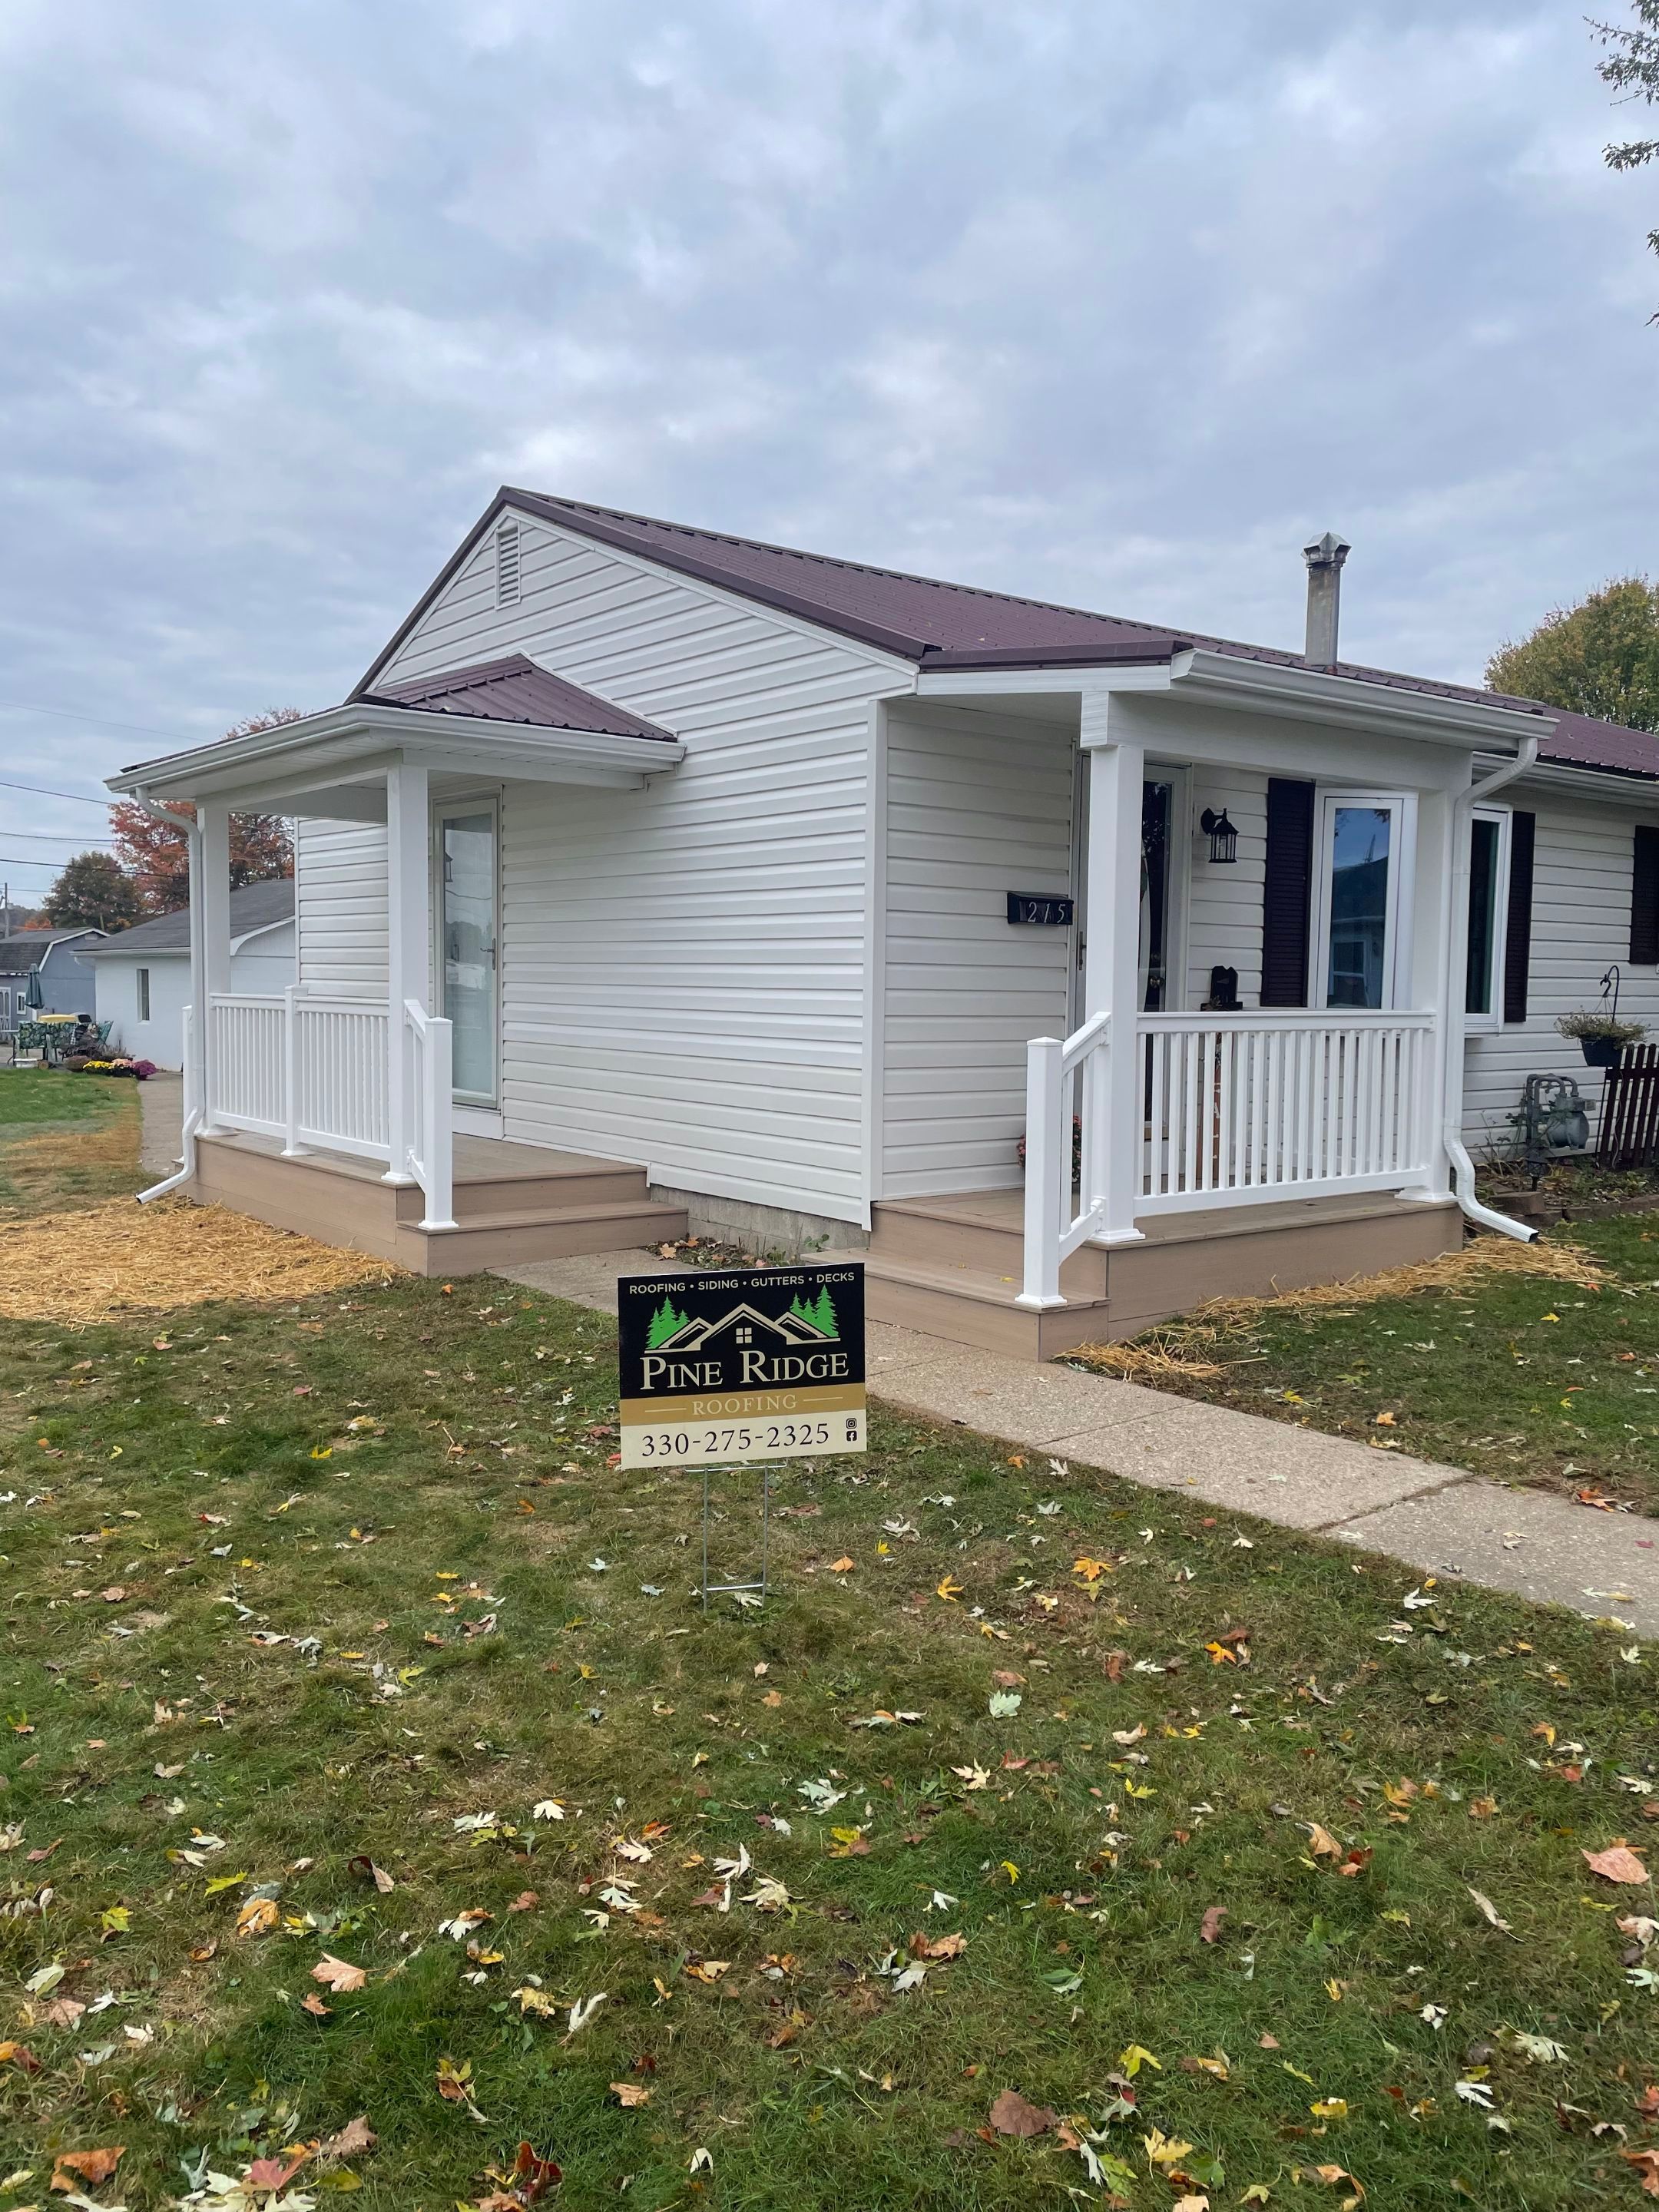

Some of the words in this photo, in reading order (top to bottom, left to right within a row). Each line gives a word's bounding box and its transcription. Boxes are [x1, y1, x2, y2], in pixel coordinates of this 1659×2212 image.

[1028, 902, 1065, 923] 215
[629, 1282, 686, 1295] ROOFING
[697, 1279, 739, 1290] SIDING
[750, 1275, 805, 1287] GUTTERS
[816, 1272, 855, 1283] DECKS
[640, 1356, 723, 1389] PINE
[739, 1350, 849, 1383] RIDGE
[692, 1394, 798, 1416] ROOFING
[641, 1423, 830, 1456] 330-275-2325
